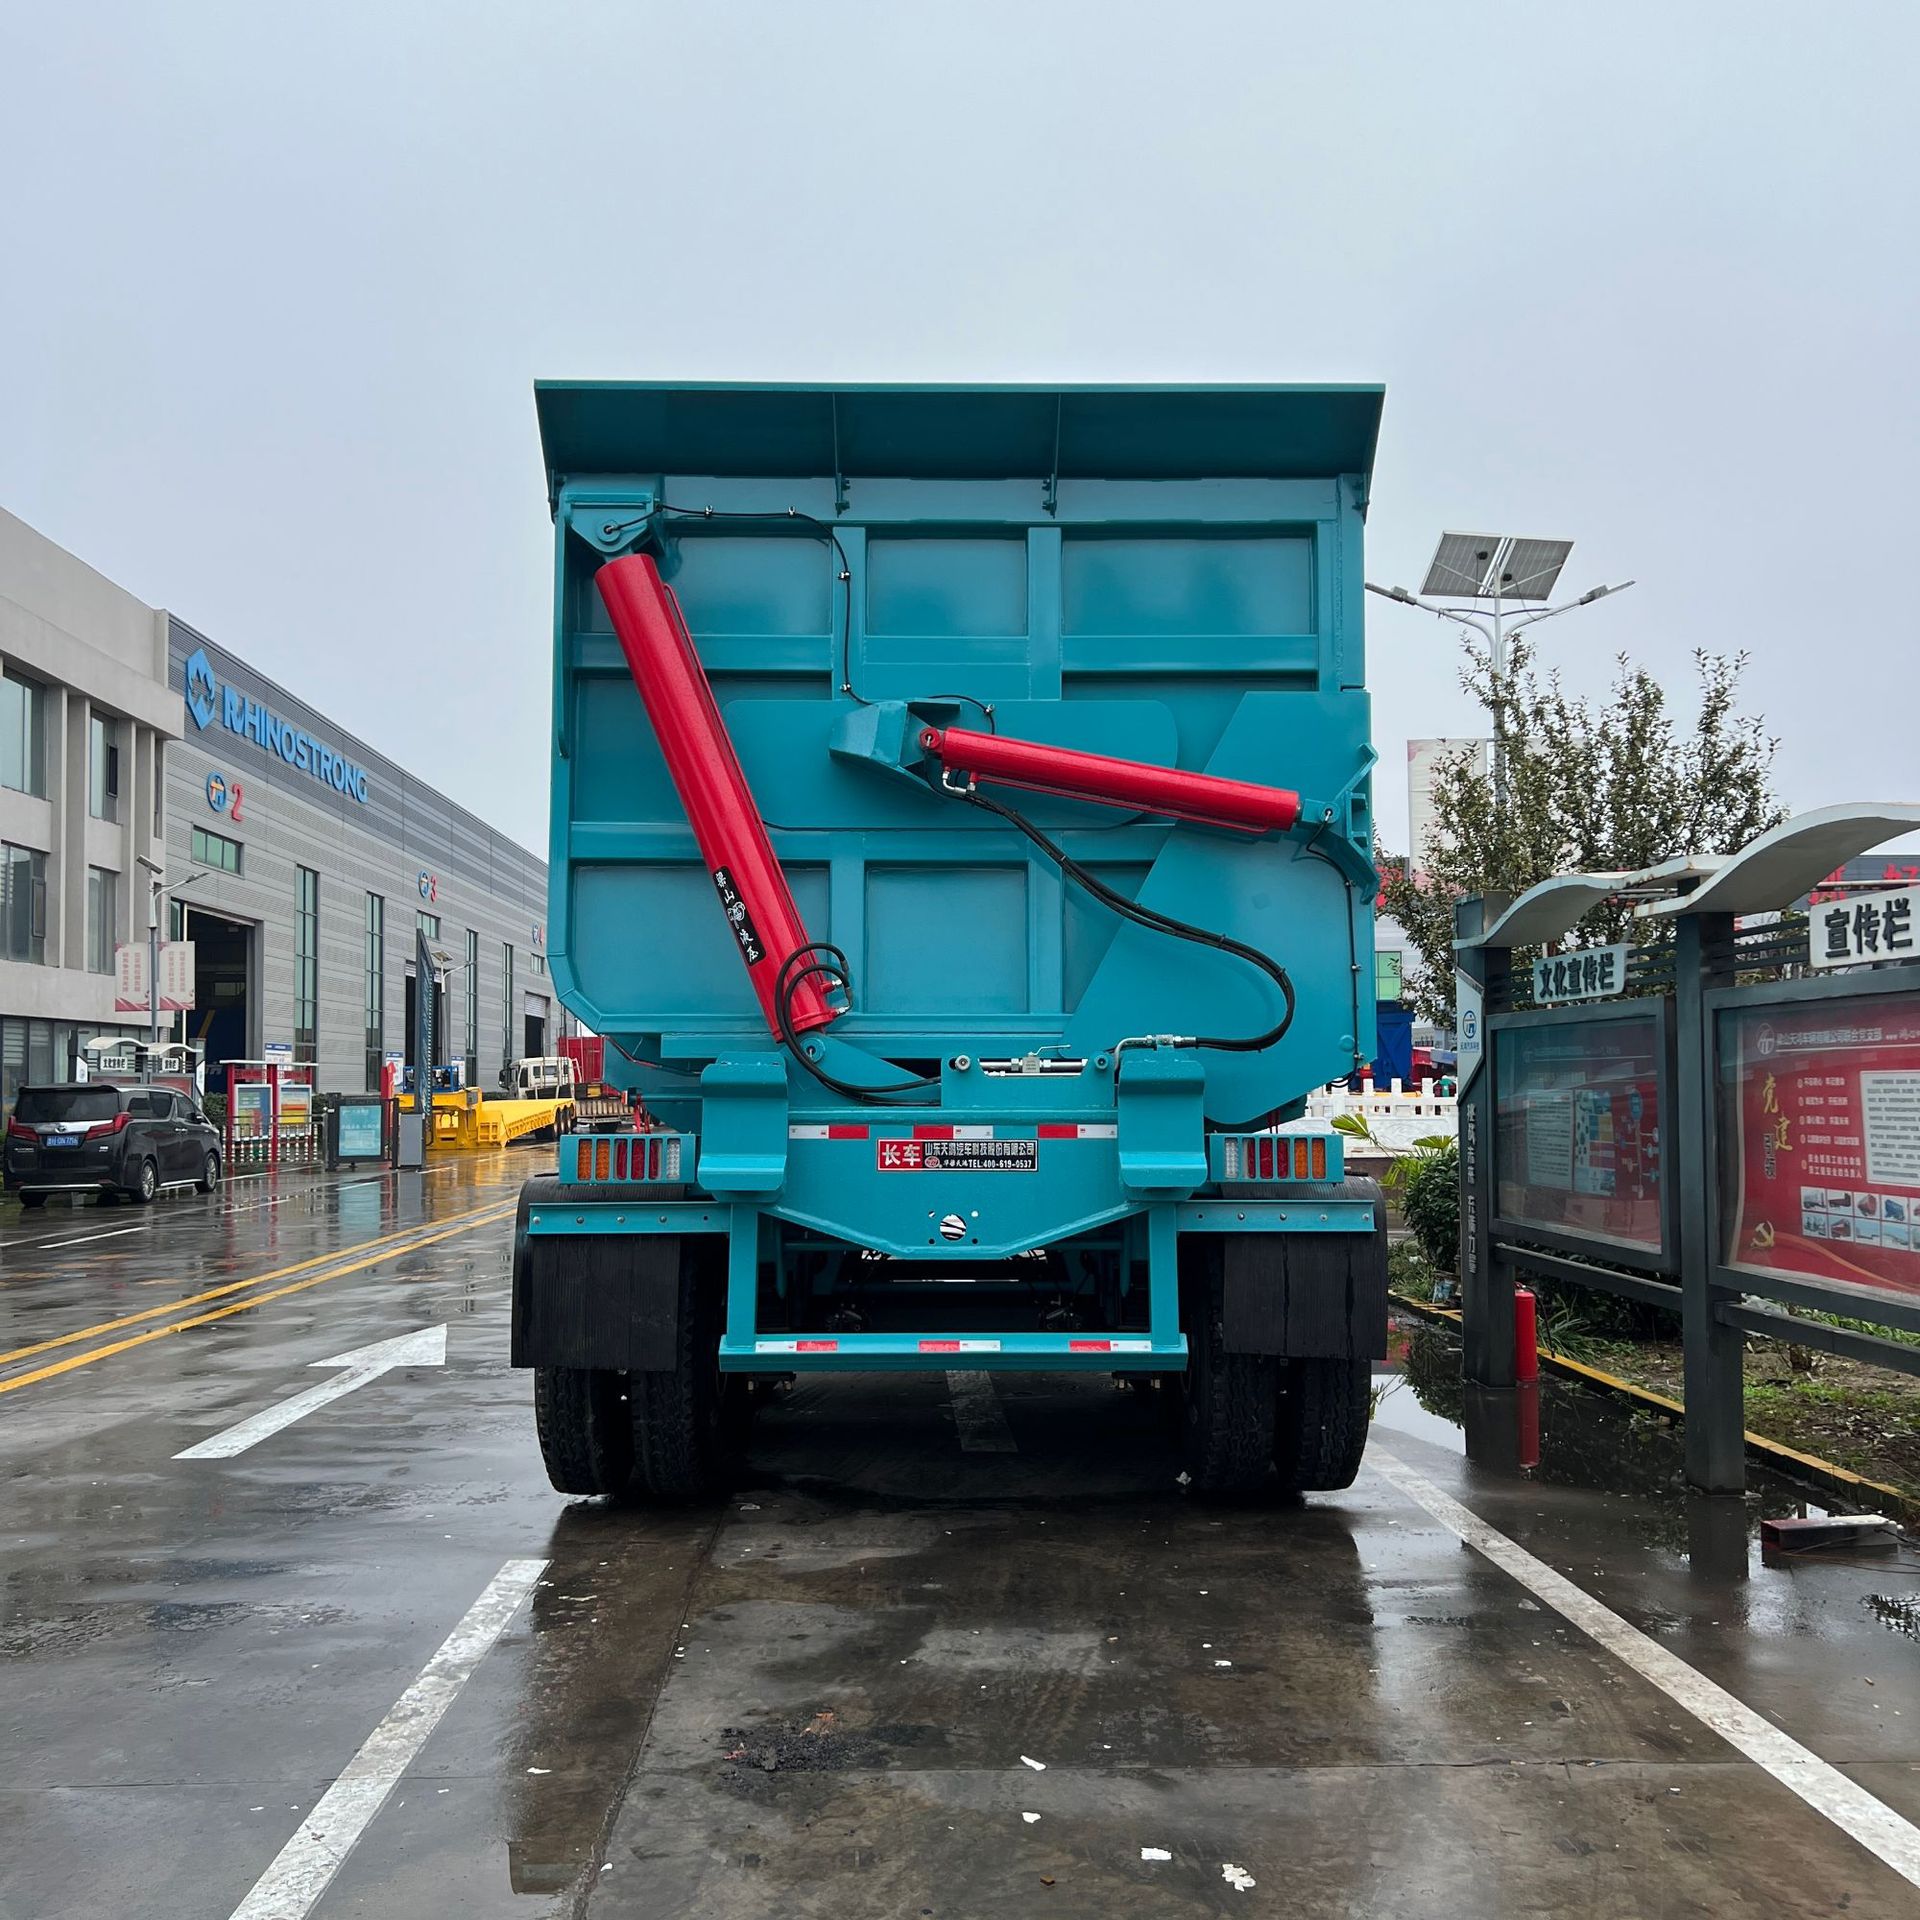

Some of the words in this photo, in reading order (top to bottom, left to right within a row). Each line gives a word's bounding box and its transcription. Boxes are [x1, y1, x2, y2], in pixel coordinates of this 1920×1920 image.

[223, 684, 369, 804] RHINOSTRONG
[231, 783, 244, 822] 2
[430, 875, 438, 902] 3
[1825, 898, 1913, 959] 宣传栏
[1539, 952, 1615, 998] 文化宣传栏
[882, 1143, 921, 1167] 长车
